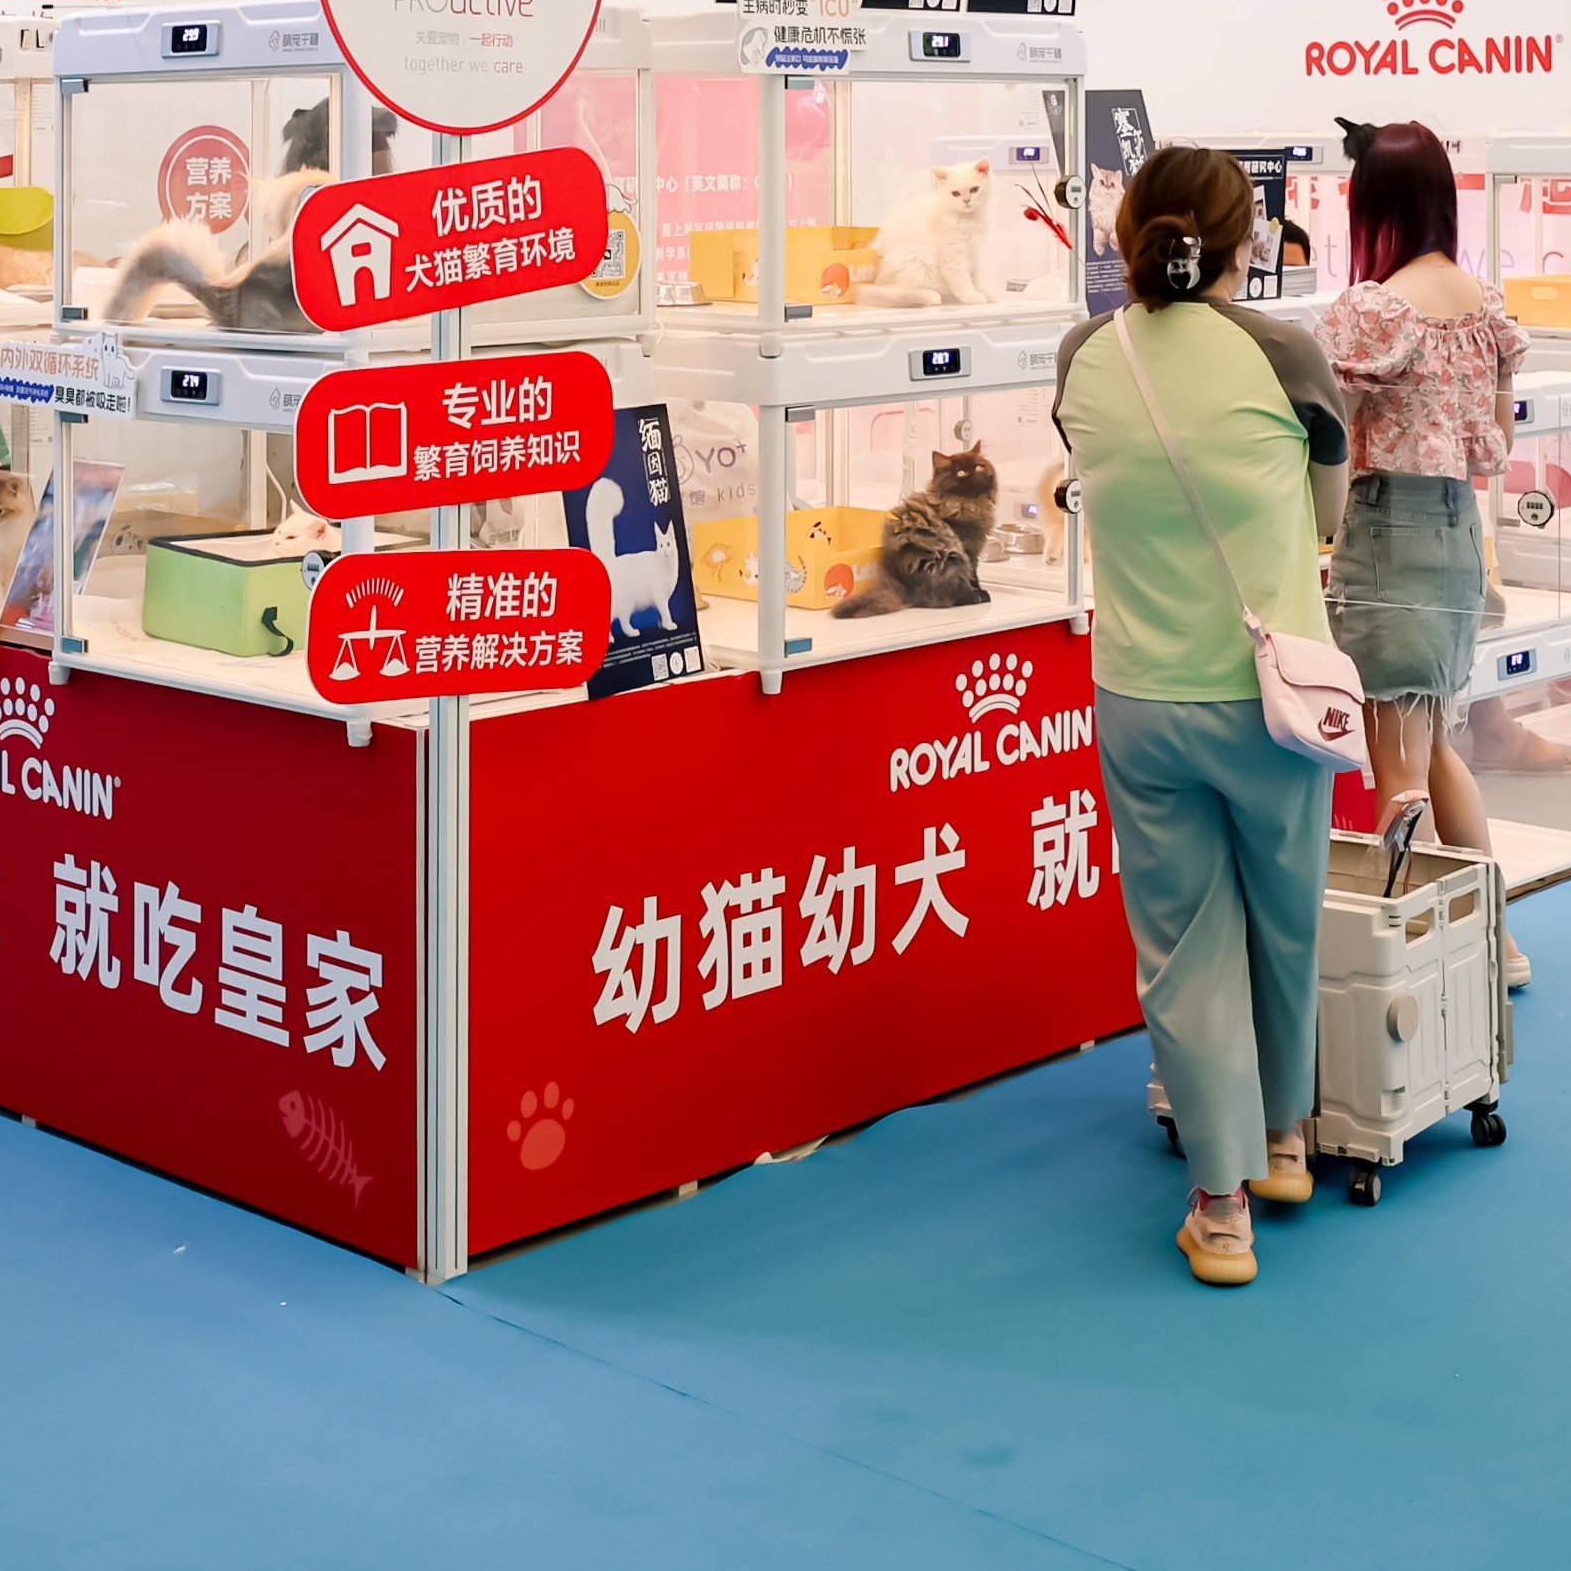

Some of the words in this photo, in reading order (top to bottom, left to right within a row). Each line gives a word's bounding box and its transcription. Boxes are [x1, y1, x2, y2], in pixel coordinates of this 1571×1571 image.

[493, 59, 524, 74] care
[1306, 38, 1419, 76] ROYAL
[1427, 34, 1553, 74] CANIN
[185, 156, 233, 188] 营养
[185, 191, 233, 219] 方案
[431, 174, 543, 237] 优质的
[405, 226, 576, 293] 犬猫繁育环境
[1, 347, 100, 380] 内外双循环系统
[442, 375, 553, 430] 专业的
[413, 429, 581, 482] 繁育饲养知识
[638, 418, 669, 507] 缅因猫
[717, 483, 757, 503] kids
[445, 570, 558, 621] 精准的
[415, 628, 584, 675] 营养解决方案
[1323, 706, 1351, 732] NIKE
[889, 731, 990, 792] ROYAL
[995, 706, 1094, 765] CANIN
[20, 756, 114, 820] CANIN
[591, 822, 970, 1035] 幼猫幼犬
[1026, 788, 1121, 912] 就
[49, 853, 387, 1072] 就吃皇家
